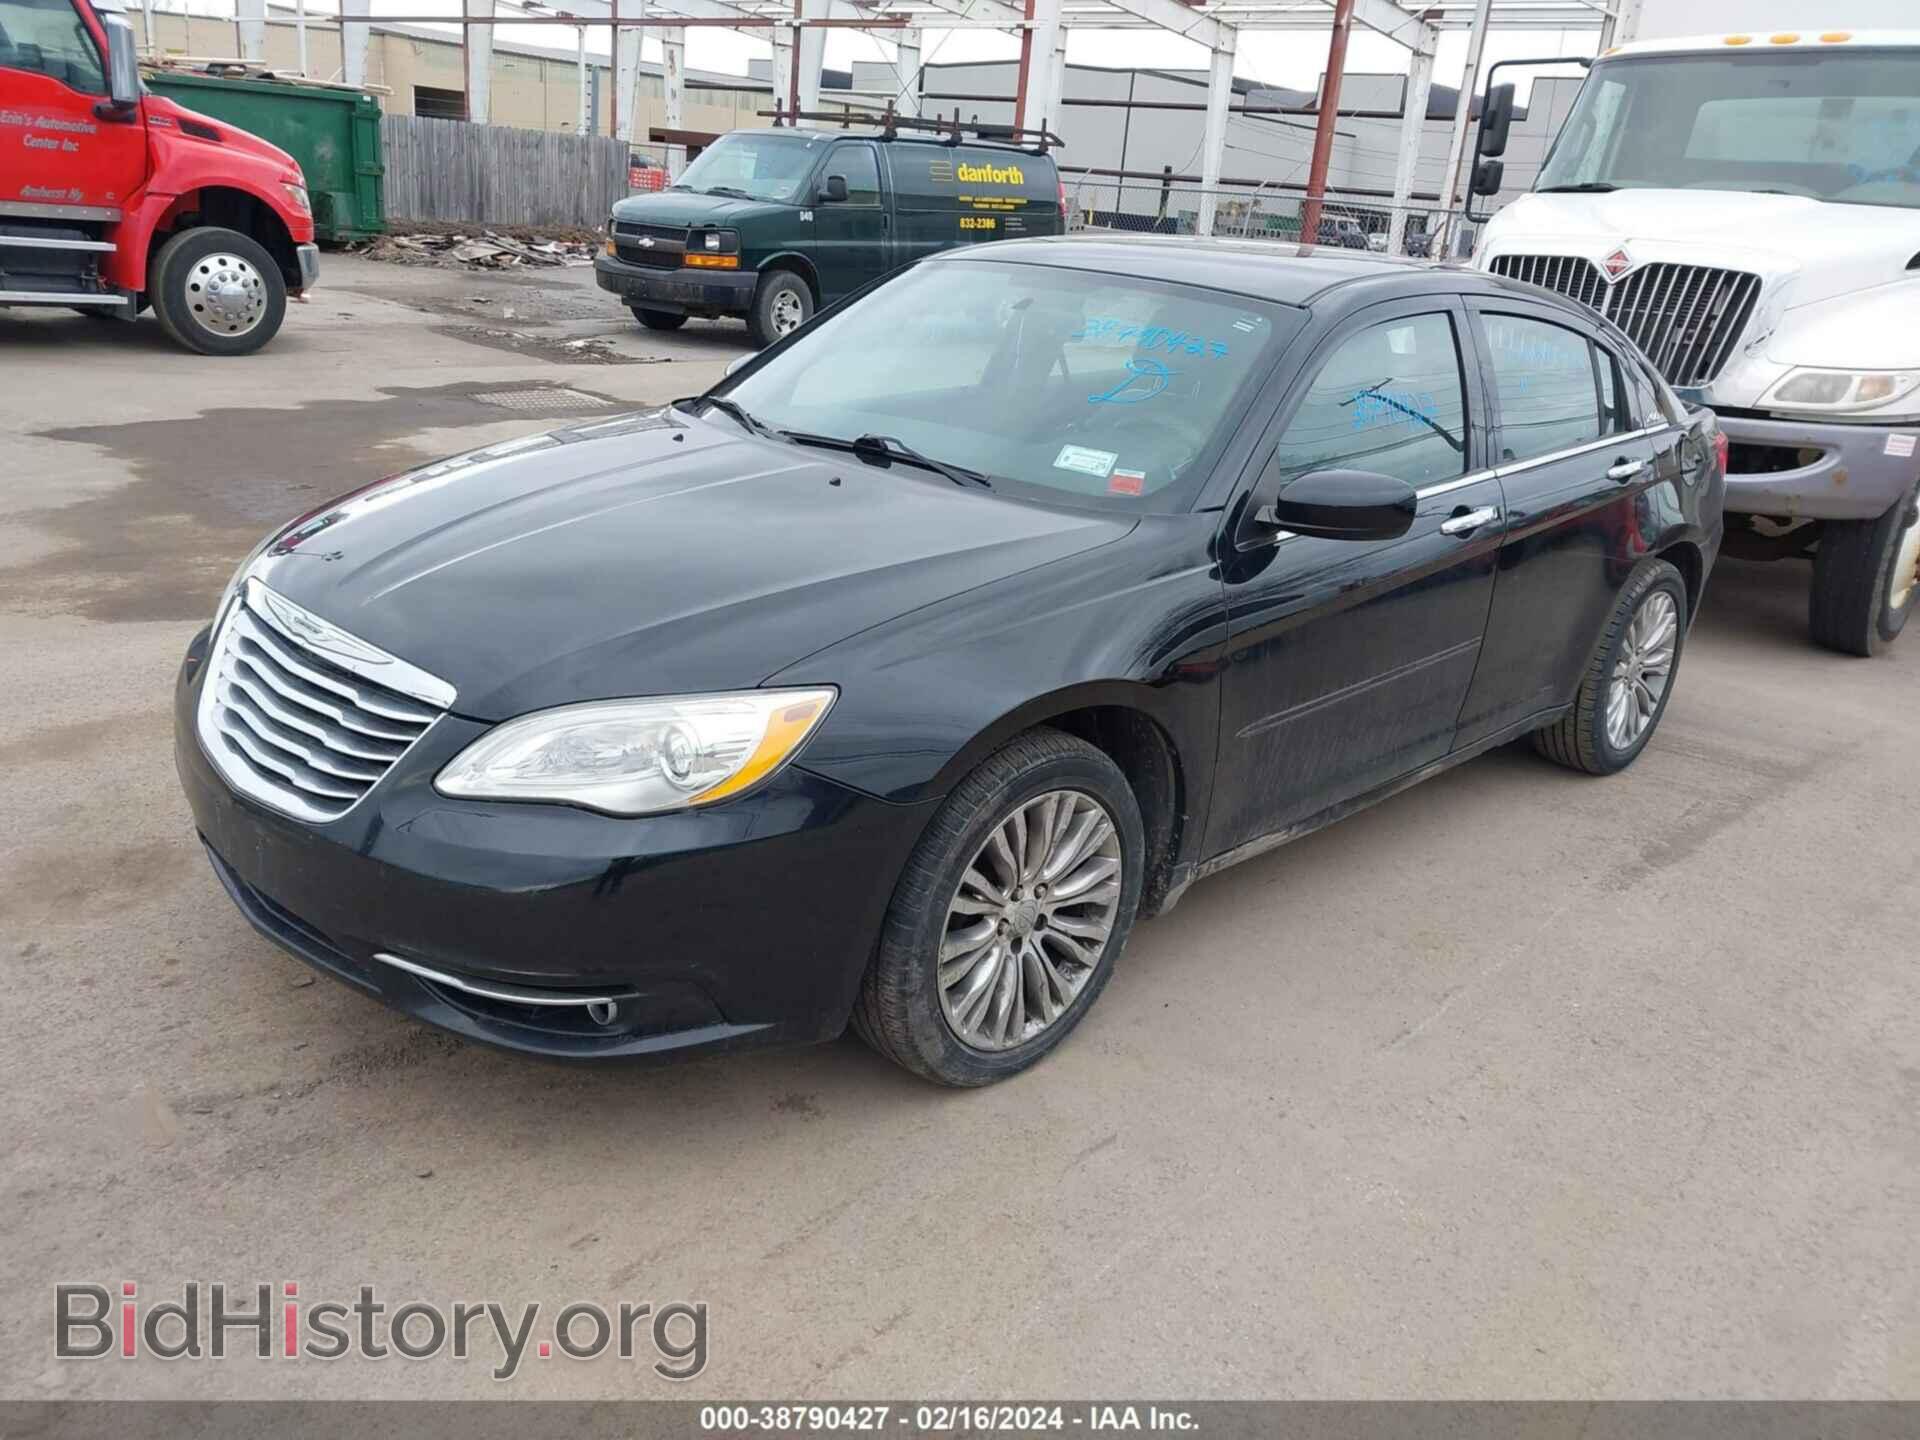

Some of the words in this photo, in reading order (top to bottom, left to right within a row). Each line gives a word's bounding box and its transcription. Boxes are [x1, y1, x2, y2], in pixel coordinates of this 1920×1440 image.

[35, 116, 97, 134] Automotive
[23, 134, 59, 149] Center
[62, 138, 80, 152] Inc
[958, 163, 1024, 185] danforth
